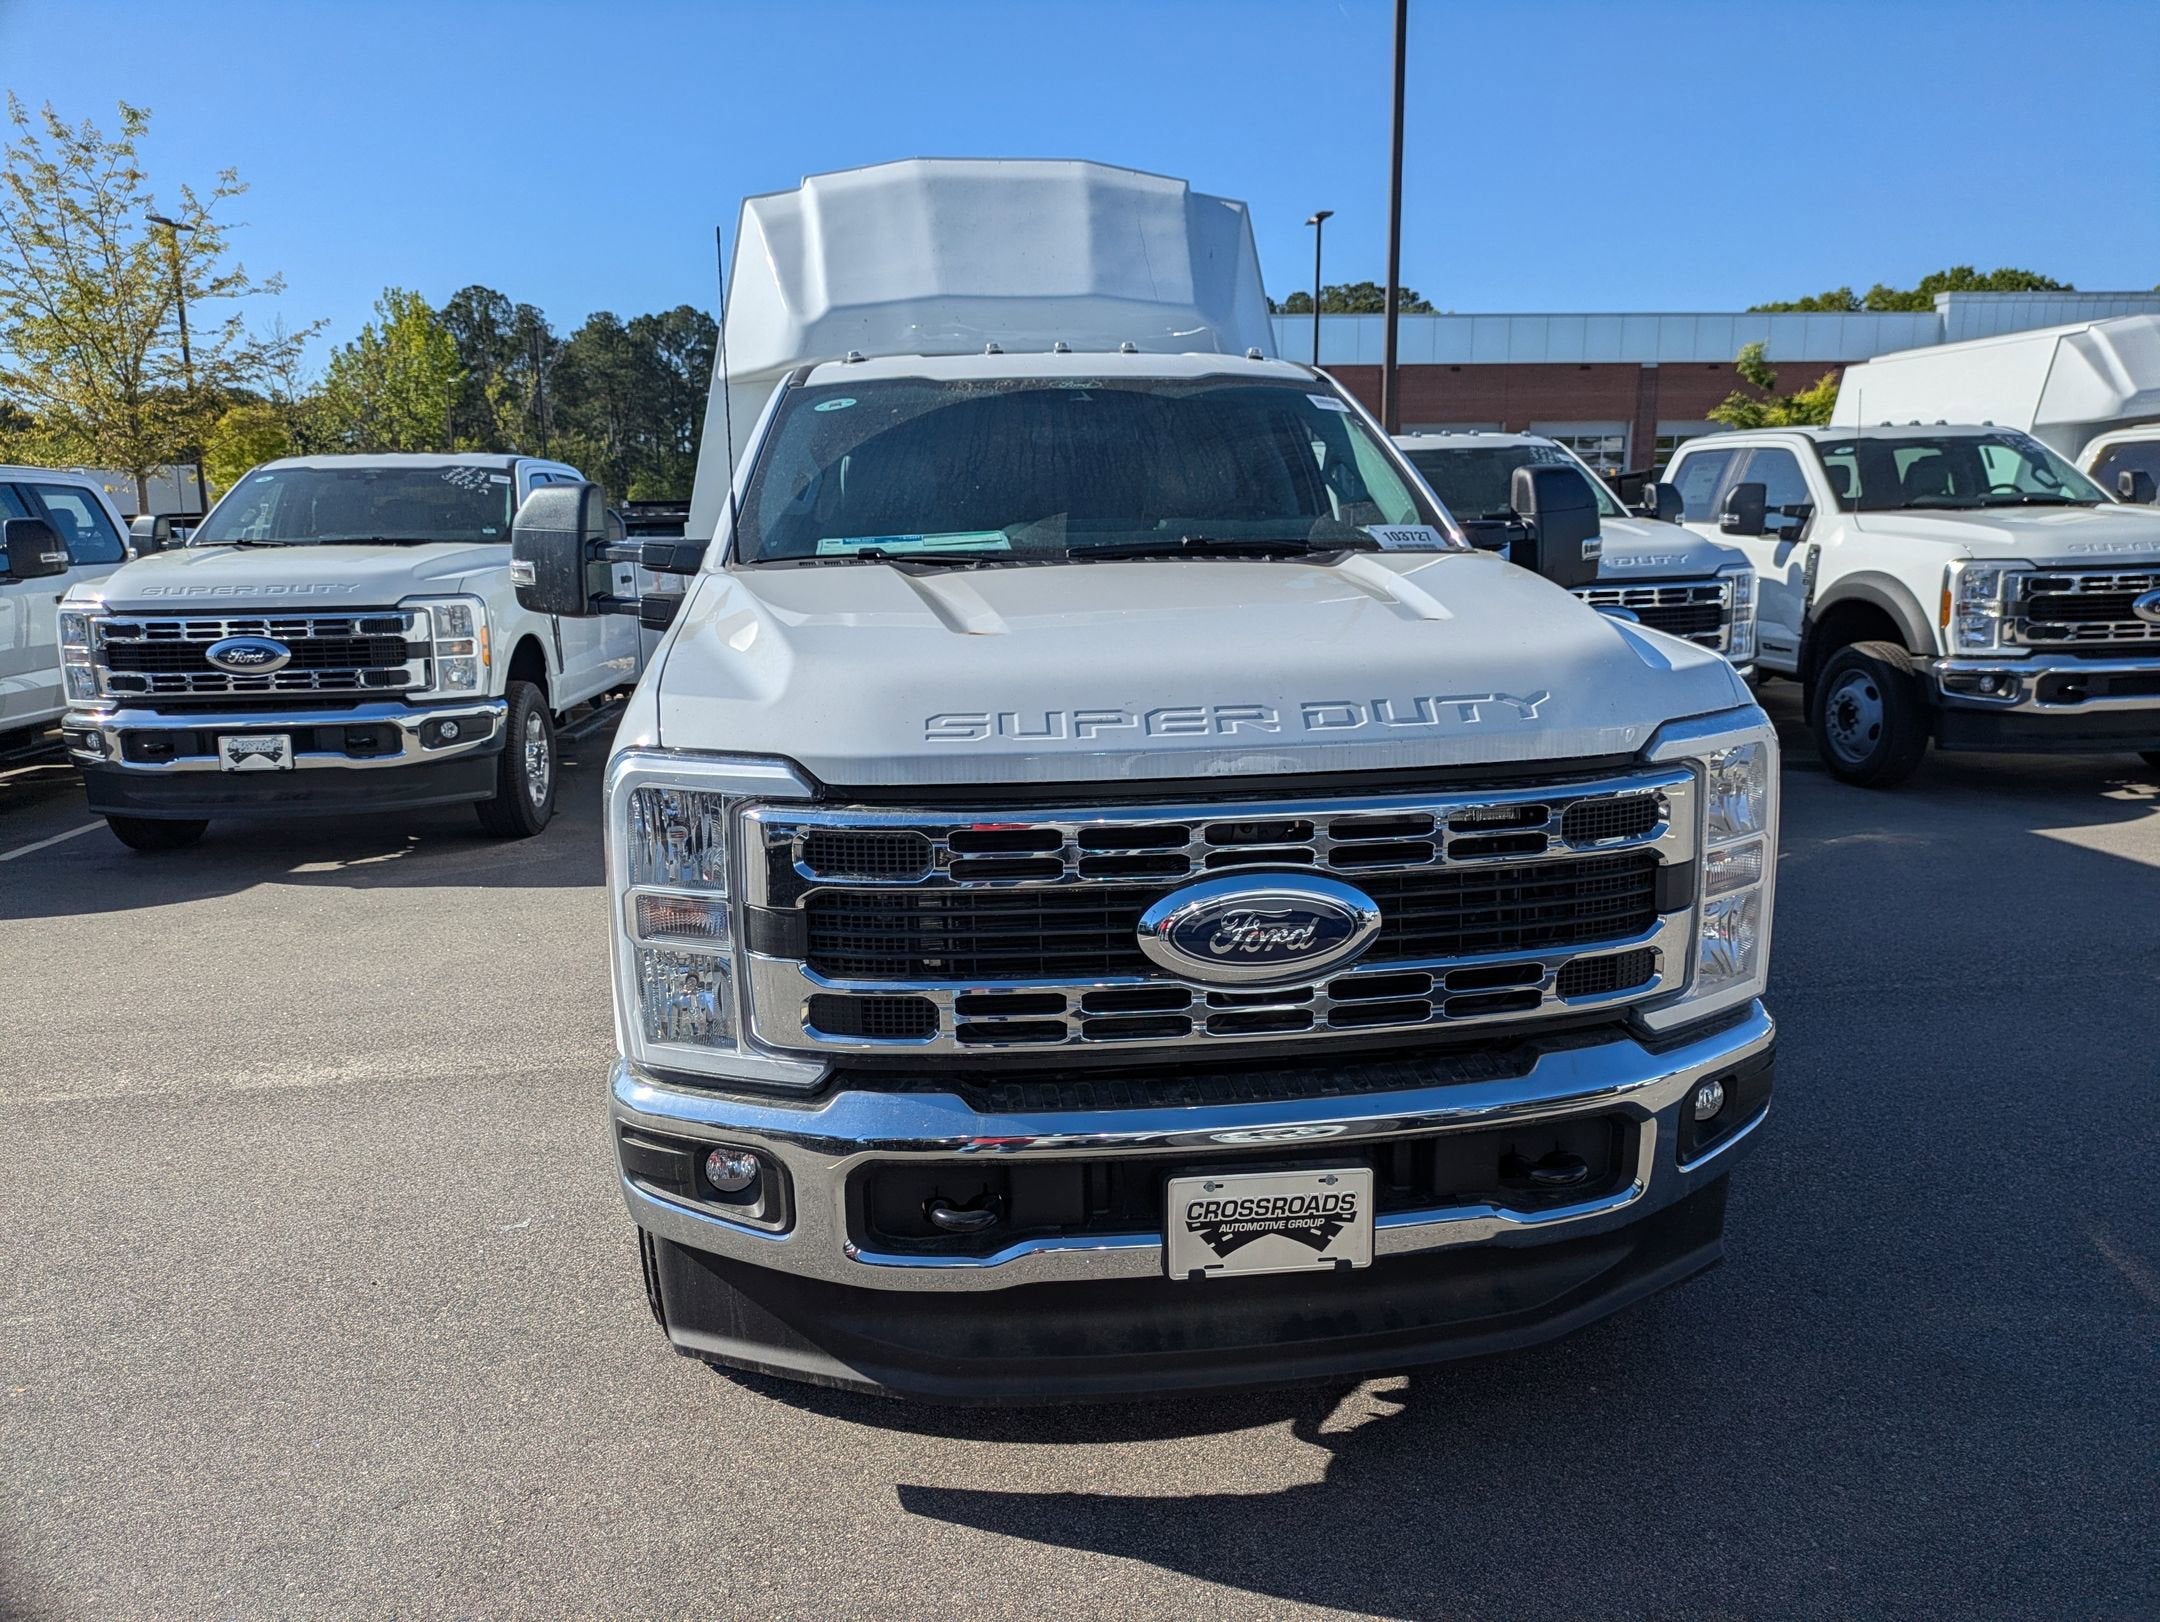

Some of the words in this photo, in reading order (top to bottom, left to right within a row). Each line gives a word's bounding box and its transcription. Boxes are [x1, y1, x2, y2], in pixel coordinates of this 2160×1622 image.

[1383, 531, 1431, 542] 103727
[1614, 554, 1688, 567] DUTY
[141, 585, 258, 597] SUPER
[265, 583, 360, 596] DUTY
[227, 647, 265, 664] Ford
[924, 704, 1282, 742] SUPER
[1300, 690, 1550, 731] DUTY
[1209, 908, 1320, 955] Ford
[1186, 1192, 1357, 1223] CROSSROADS
[1219, 1219, 1286, 1233] AUTOMOTIVE
[1288, 1217, 1325, 1229] GROUP
